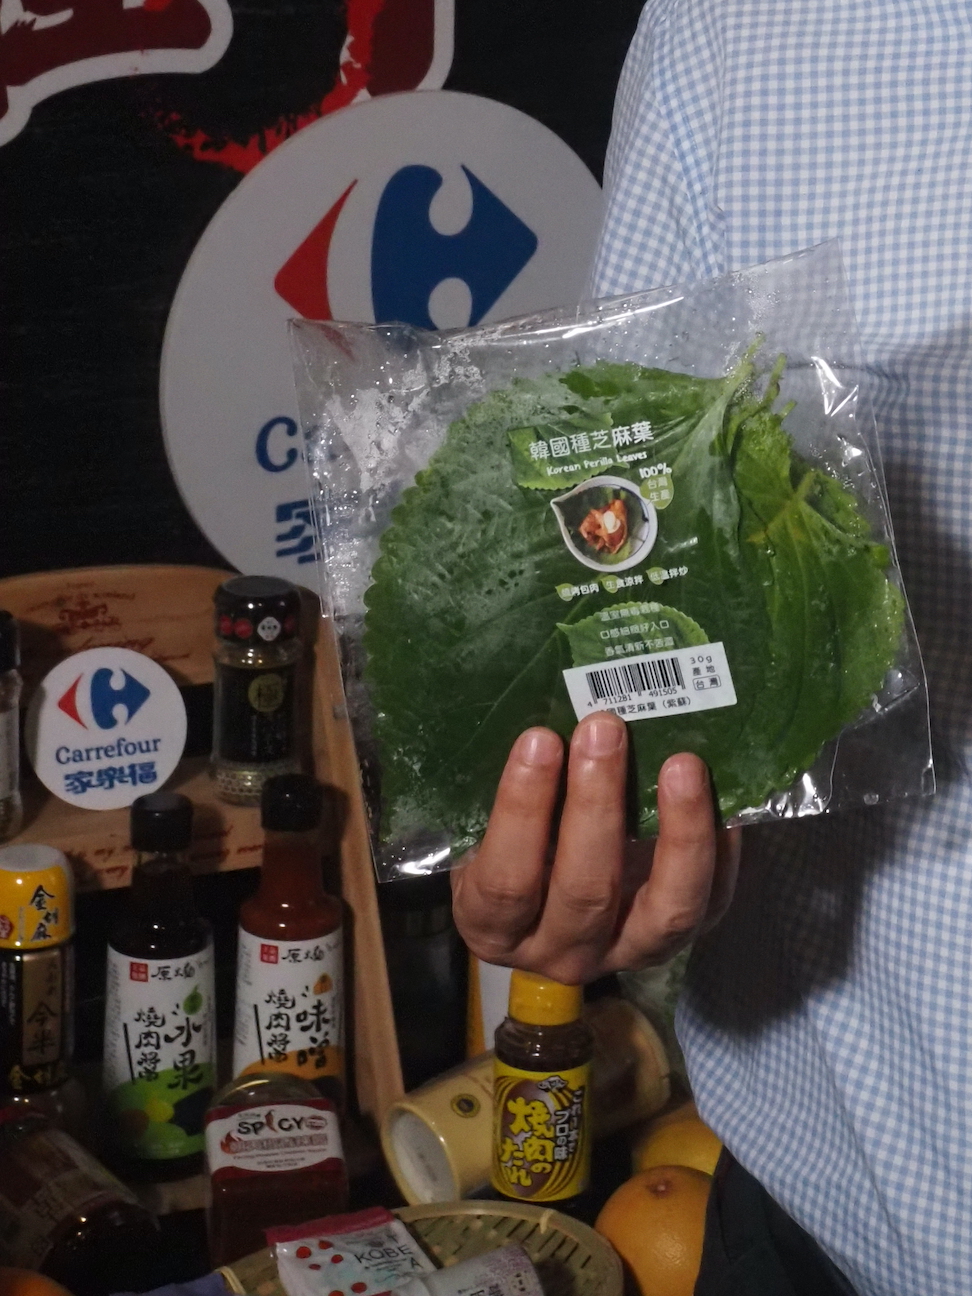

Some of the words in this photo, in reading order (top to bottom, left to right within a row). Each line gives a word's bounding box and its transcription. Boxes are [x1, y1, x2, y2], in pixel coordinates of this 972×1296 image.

[529, 421, 654, 460] 韓國種芝麻葉
[547, 464, 581, 476] Korean
[583, 456, 613, 469] Perilla
[616, 451, 647, 462] Leaves
[639, 463, 673, 479] 100%
[602, 695, 632, 705] 711281
[648, 688, 678, 697] 491505
[55, 737, 161, 765] Carrefour
[64, 761, 158, 795] 家樂福
[354, 1244, 413, 1264] KOBE
